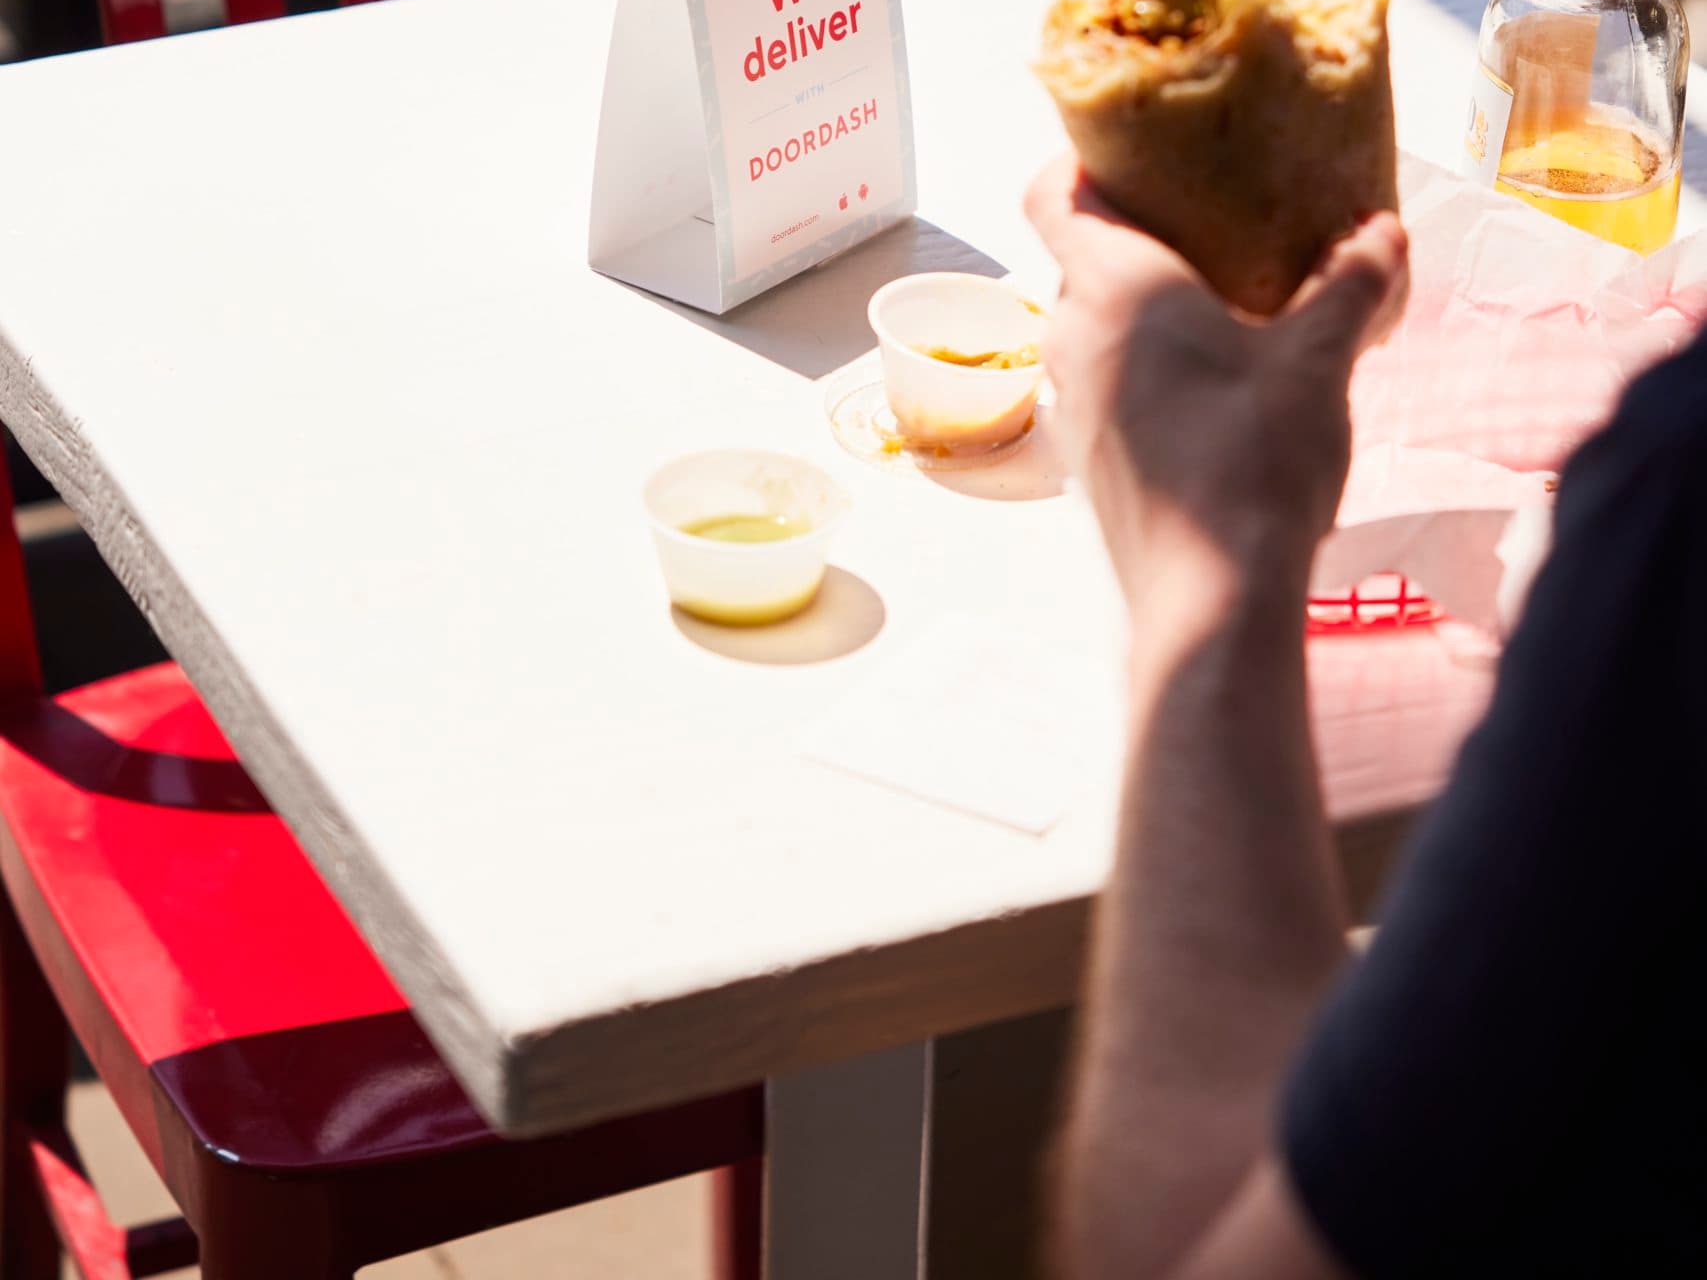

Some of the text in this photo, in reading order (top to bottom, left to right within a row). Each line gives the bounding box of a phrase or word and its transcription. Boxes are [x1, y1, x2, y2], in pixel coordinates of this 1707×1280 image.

[743, 0, 861, 82] deliver
[795, 82, 825, 106] WITH
[749, 98, 878, 182] DOORDASH
[771, 214, 820, 244] doordash.com
